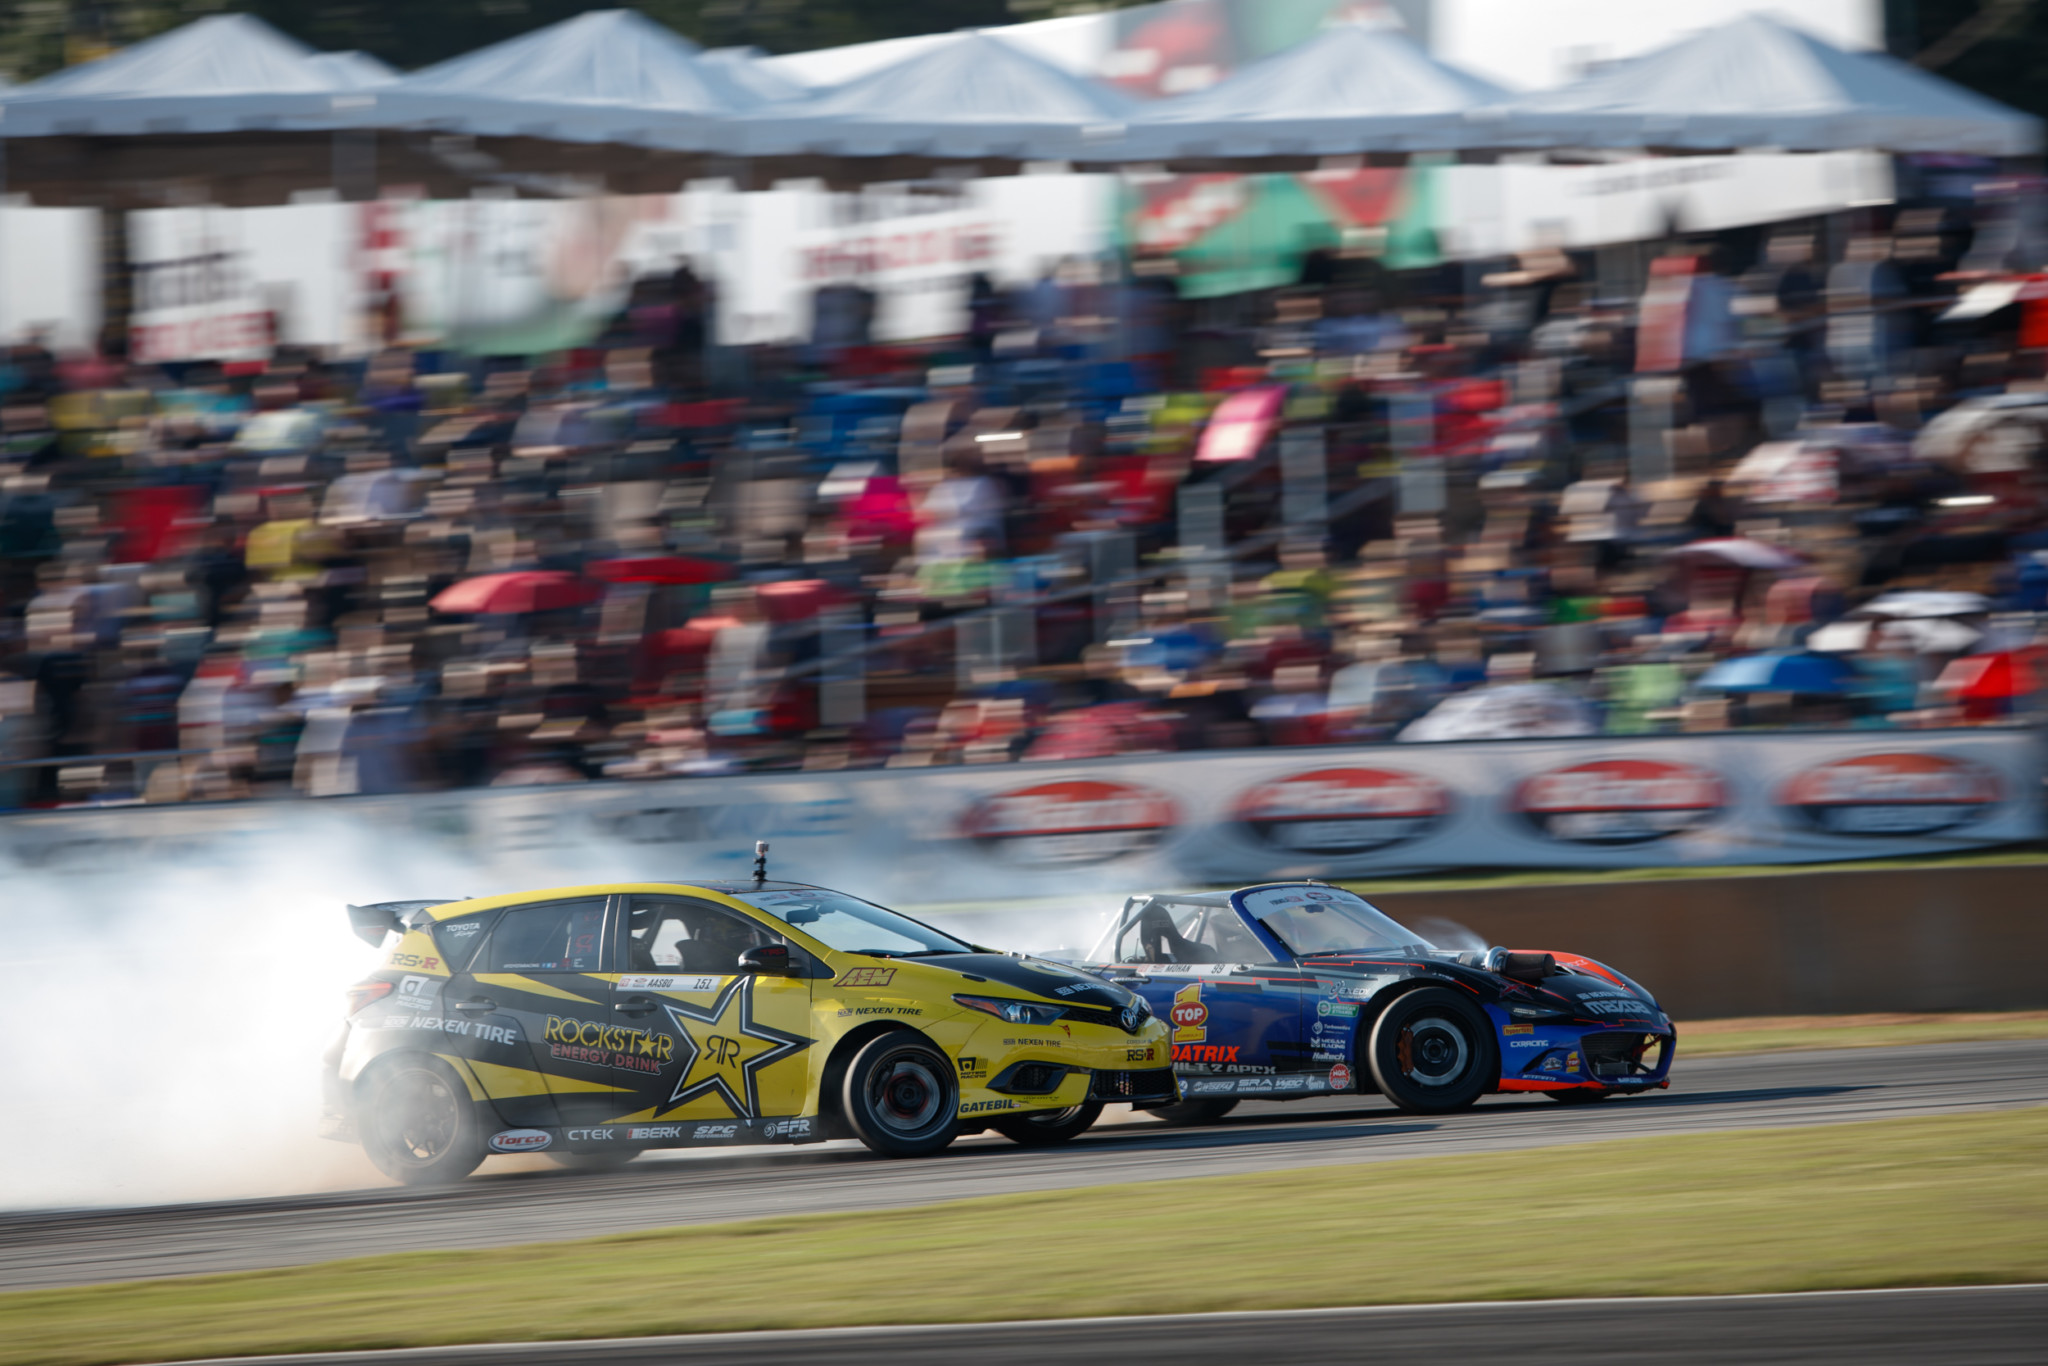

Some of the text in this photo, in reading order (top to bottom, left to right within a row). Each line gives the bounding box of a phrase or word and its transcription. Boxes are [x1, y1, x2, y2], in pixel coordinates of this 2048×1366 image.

[446, 922, 480, 932] TOYOTA
[1165, 964, 1225, 974] MOHAN 99
[833, 967, 898, 988] AEM
[647, 978, 674, 988] AASBO
[693, 978, 713, 990] 151
[855, 1007, 894, 1016] NEXEN
[896, 1007, 924, 1017] TIRE
[1176, 1008, 1203, 1021] TOP
[410, 1016, 471, 1035] NEXEN
[474, 1023, 517, 1046] TIRE
[1018, 1038, 1044, 1046] NEXEN
[1046, 1039, 1061, 1047] TIRE
[552, 1042, 661, 1073] ENERGY DRINK
[1211, 1063, 1223, 1072] 2
[960, 1099, 1014, 1114] GATEBIL
[639, 1126, 682, 1139] BERK
[694, 1125, 738, 1134] SPC
[776, 1119, 810, 1134] EFR
[497, 1134, 547, 1146] Torco
[568, 1129, 614, 1140] CTEK
